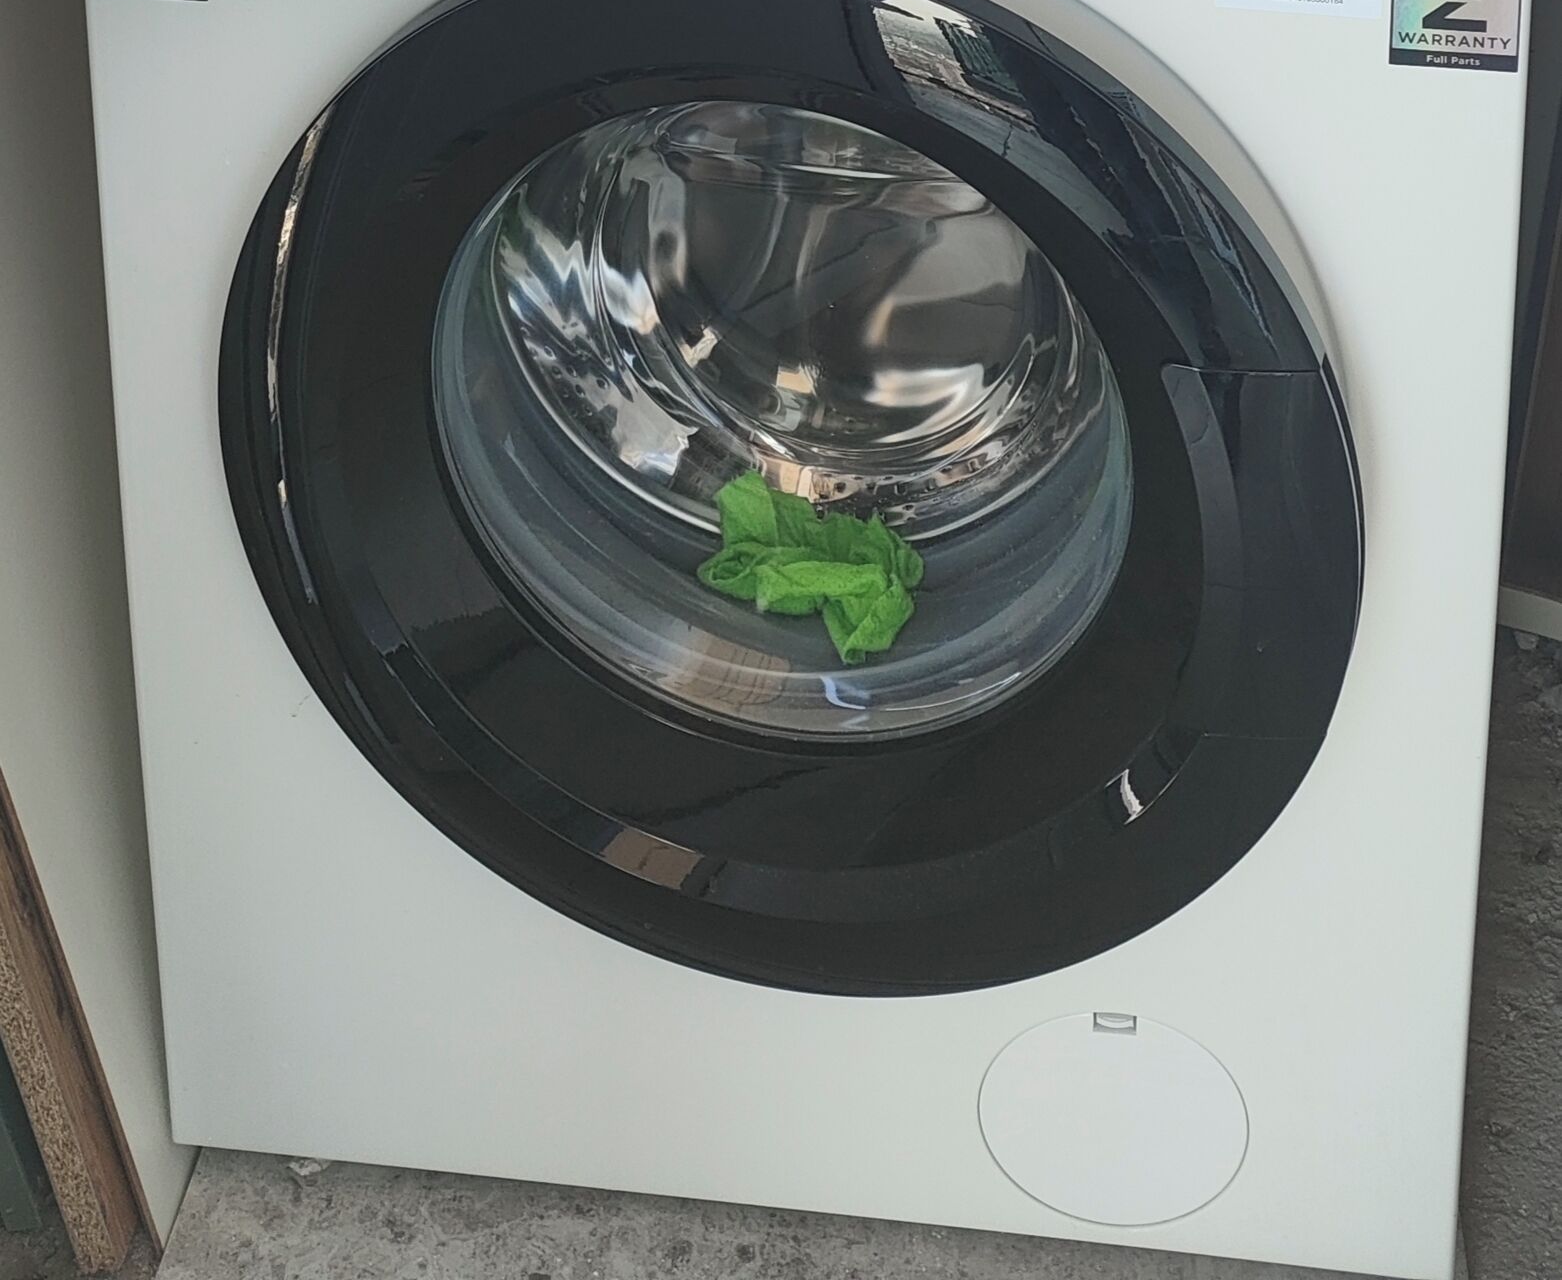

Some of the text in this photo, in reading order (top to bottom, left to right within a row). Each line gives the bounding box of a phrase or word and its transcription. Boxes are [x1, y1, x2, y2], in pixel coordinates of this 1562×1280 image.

[1398, 31, 1512, 50] WARRANTY
[1426, 54, 1481, 66] Full Parts
